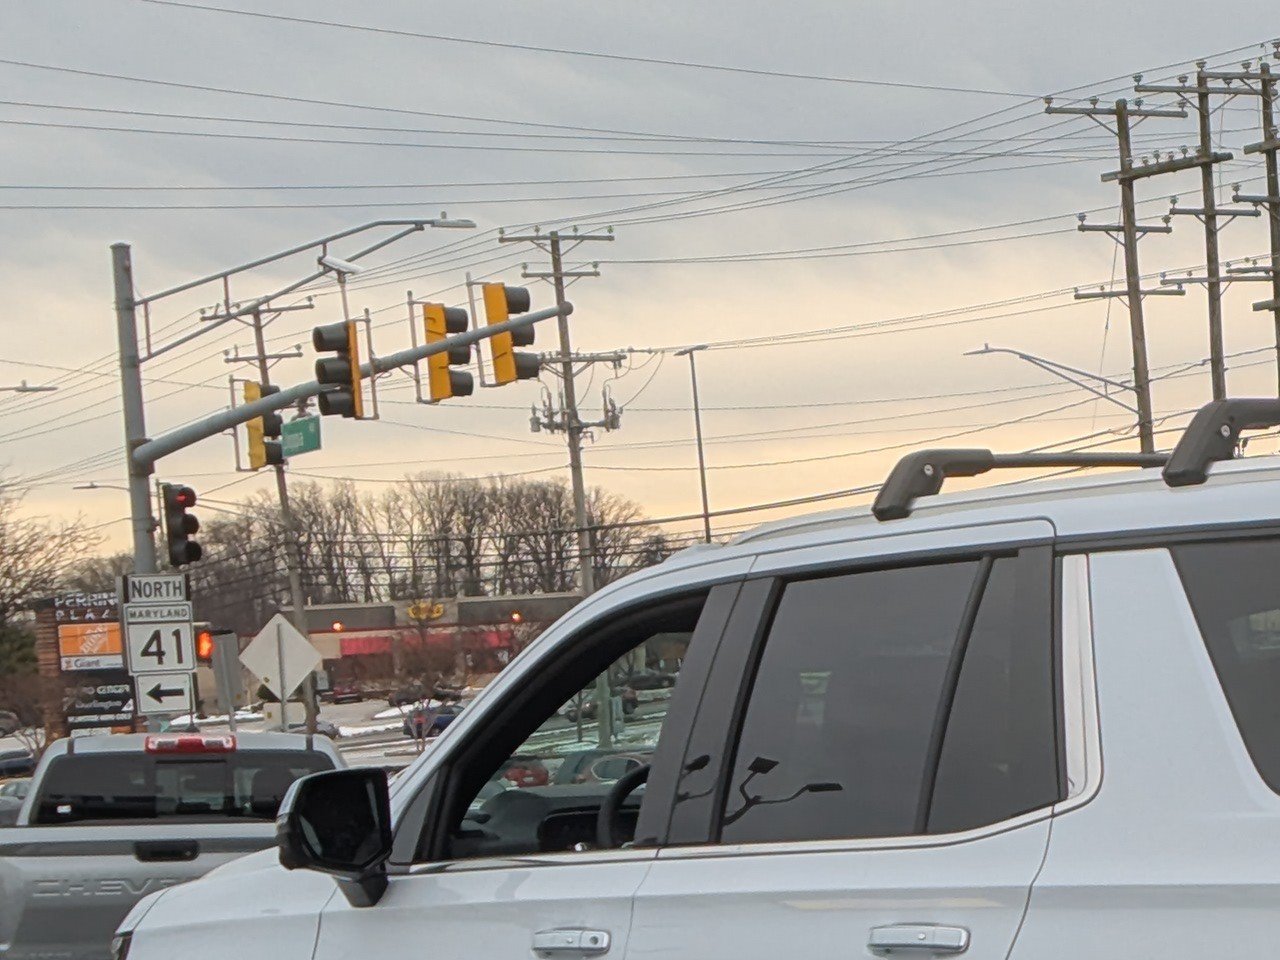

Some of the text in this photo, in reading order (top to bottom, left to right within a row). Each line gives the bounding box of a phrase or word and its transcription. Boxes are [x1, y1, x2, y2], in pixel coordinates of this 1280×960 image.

[131, 580, 182, 598] NORTH
[129, 608, 188, 619] MARYLAND
[140, 628, 183, 665] 41
